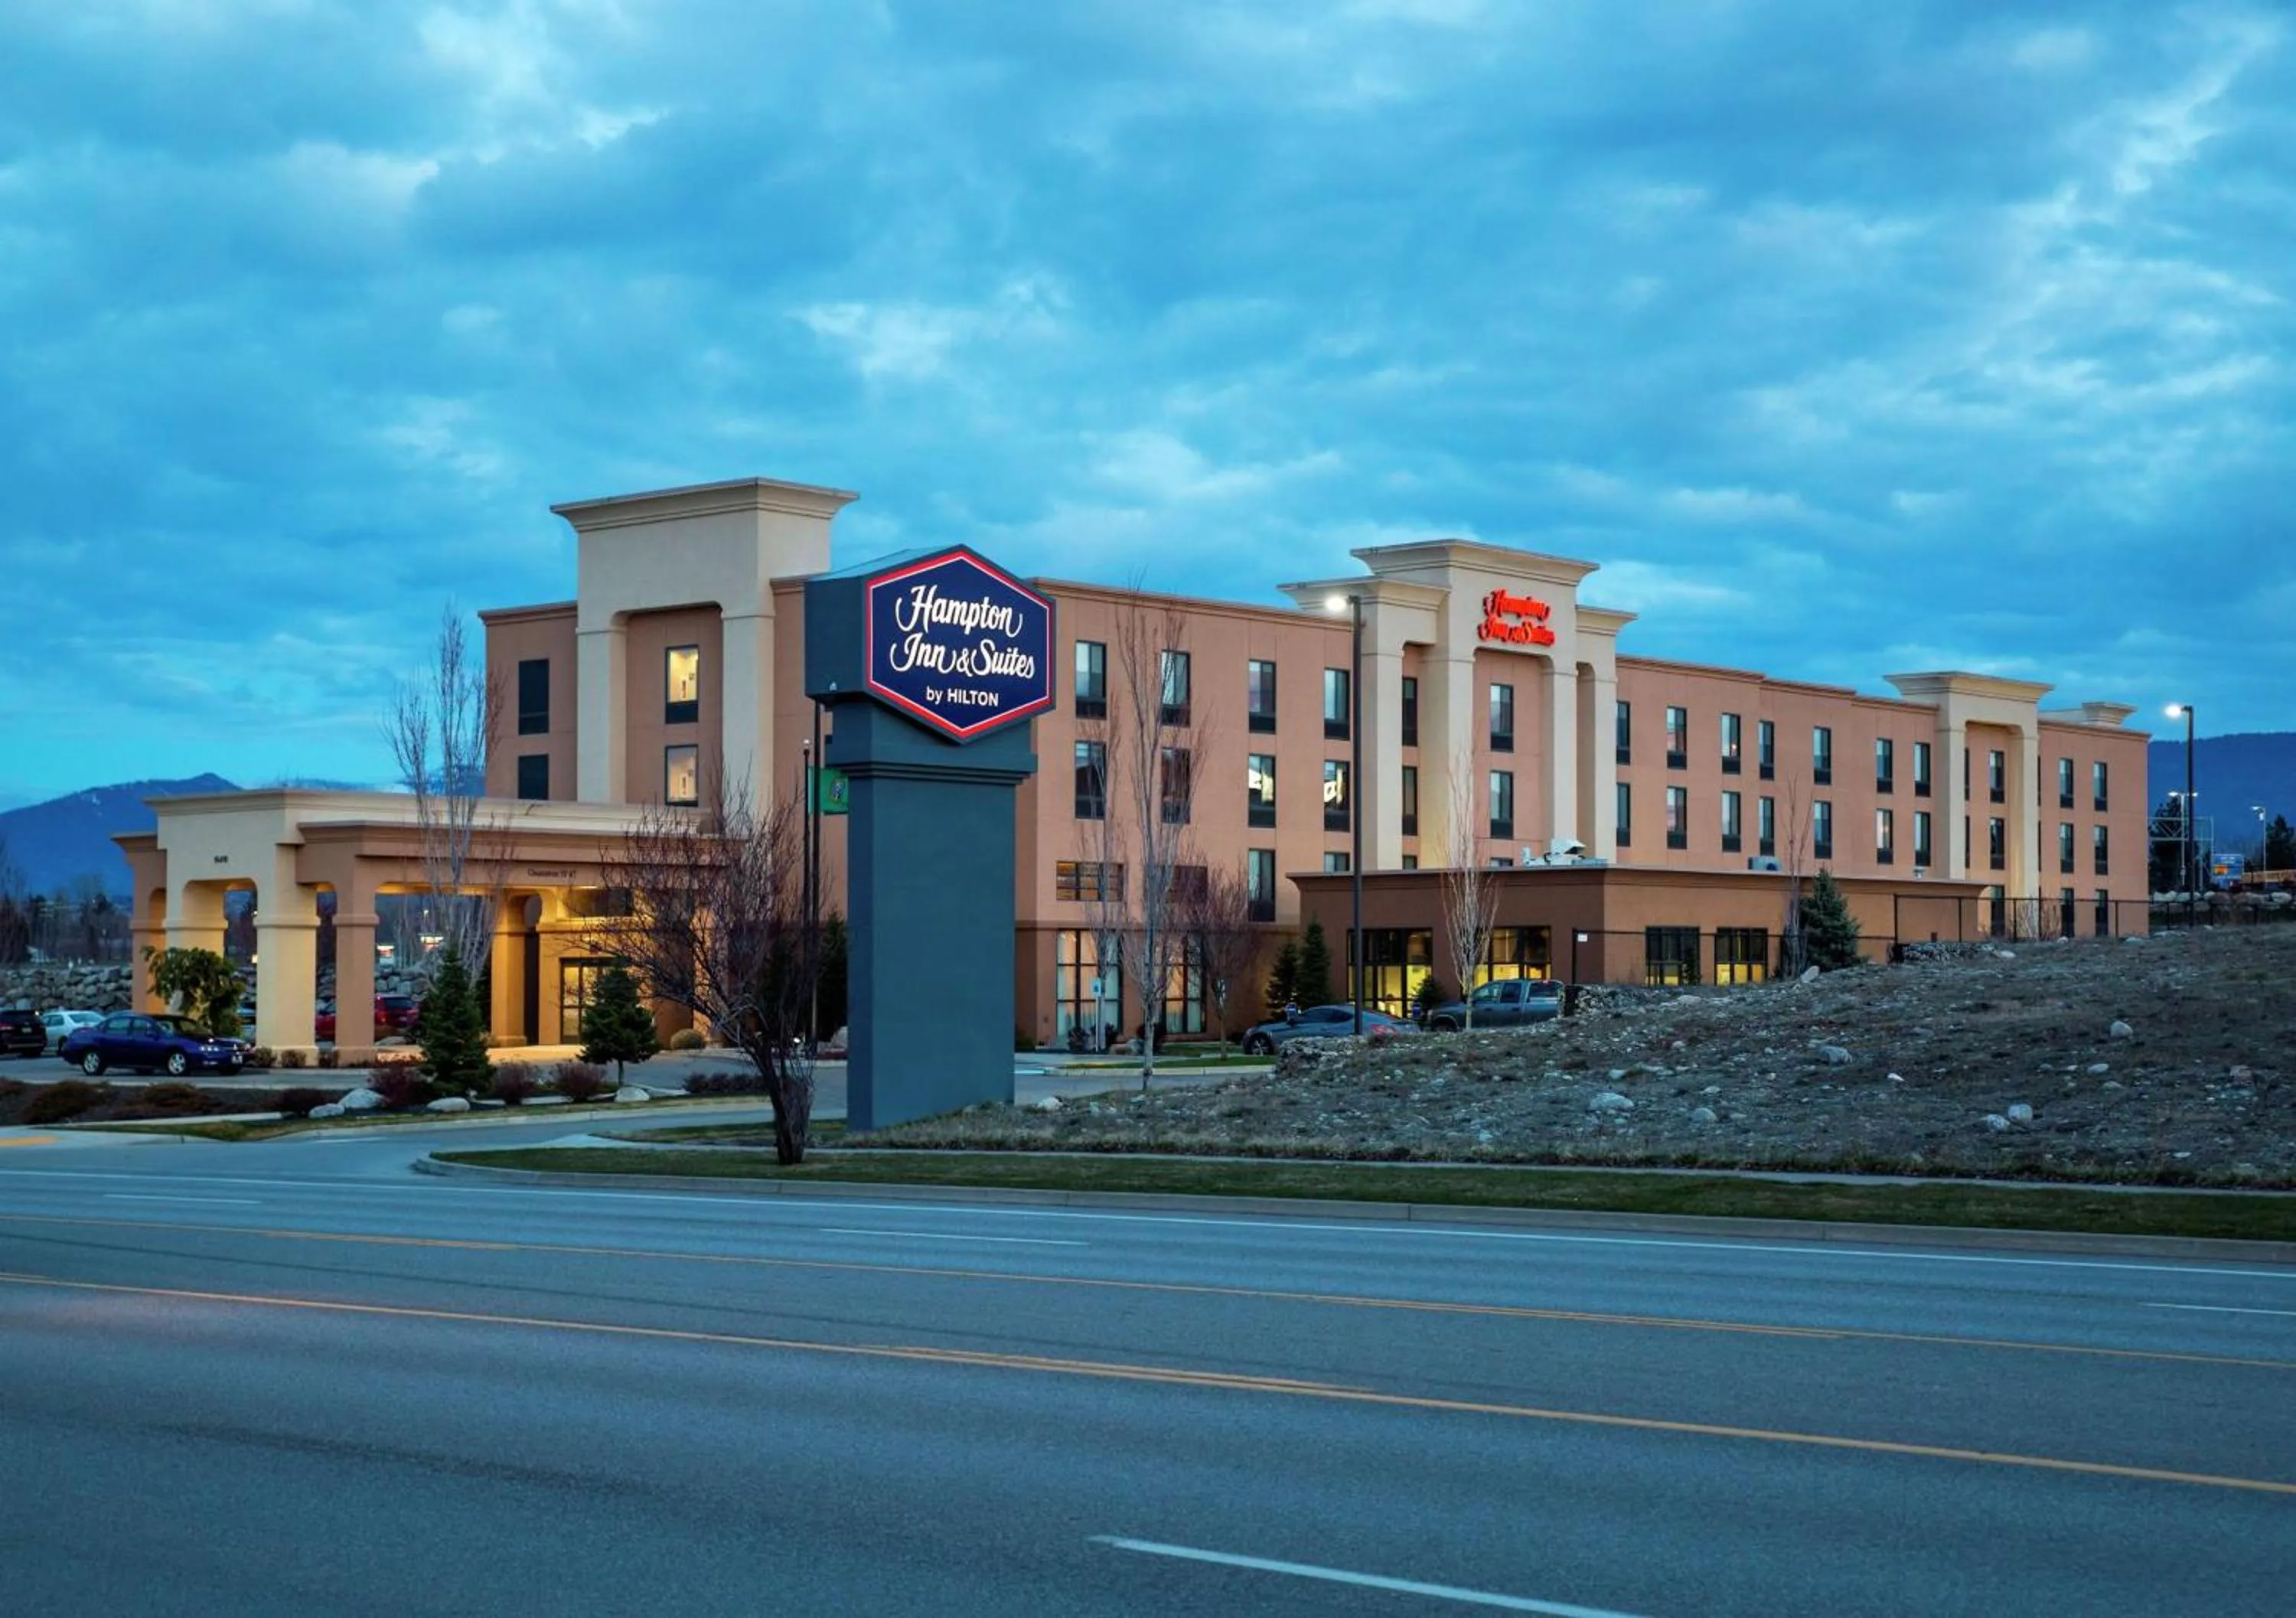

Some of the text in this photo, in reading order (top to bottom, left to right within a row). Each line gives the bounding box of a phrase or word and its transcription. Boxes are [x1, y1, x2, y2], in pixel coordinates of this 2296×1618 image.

[895, 584, 1023, 638] Hampton
[889, 632, 1036, 679] Inn & Suites
[925, 686, 1000, 707] by HILTON
